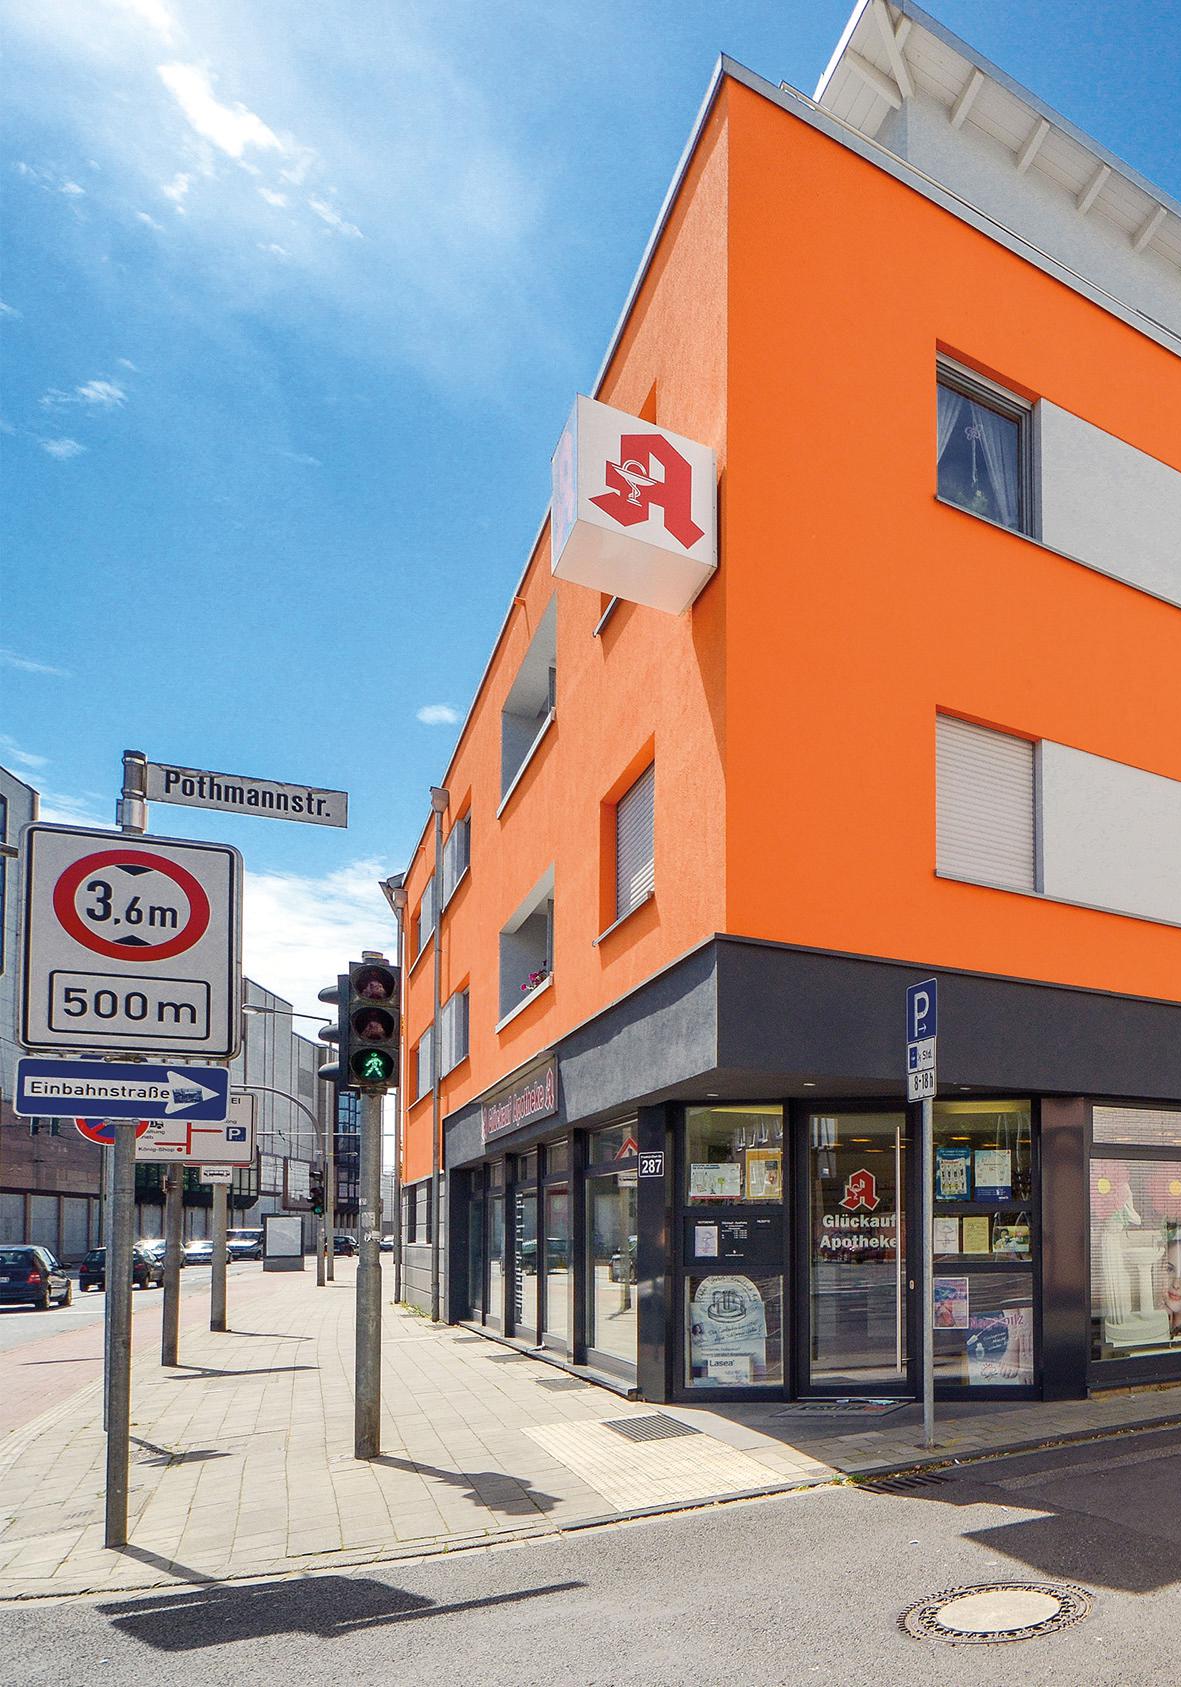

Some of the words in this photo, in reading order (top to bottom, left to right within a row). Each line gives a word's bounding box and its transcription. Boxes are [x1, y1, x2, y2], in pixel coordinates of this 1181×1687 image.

[165, 770, 331, 817] Pothmannstr.
[914, 991, 929, 1037] P
[31, 1081, 170, 1099] Einbahnstraße
[642, 1159, 662, 1173] 287
[822, 1213, 897, 1228] Glückauf
[820, 1235, 897, 1250] Apotheke
